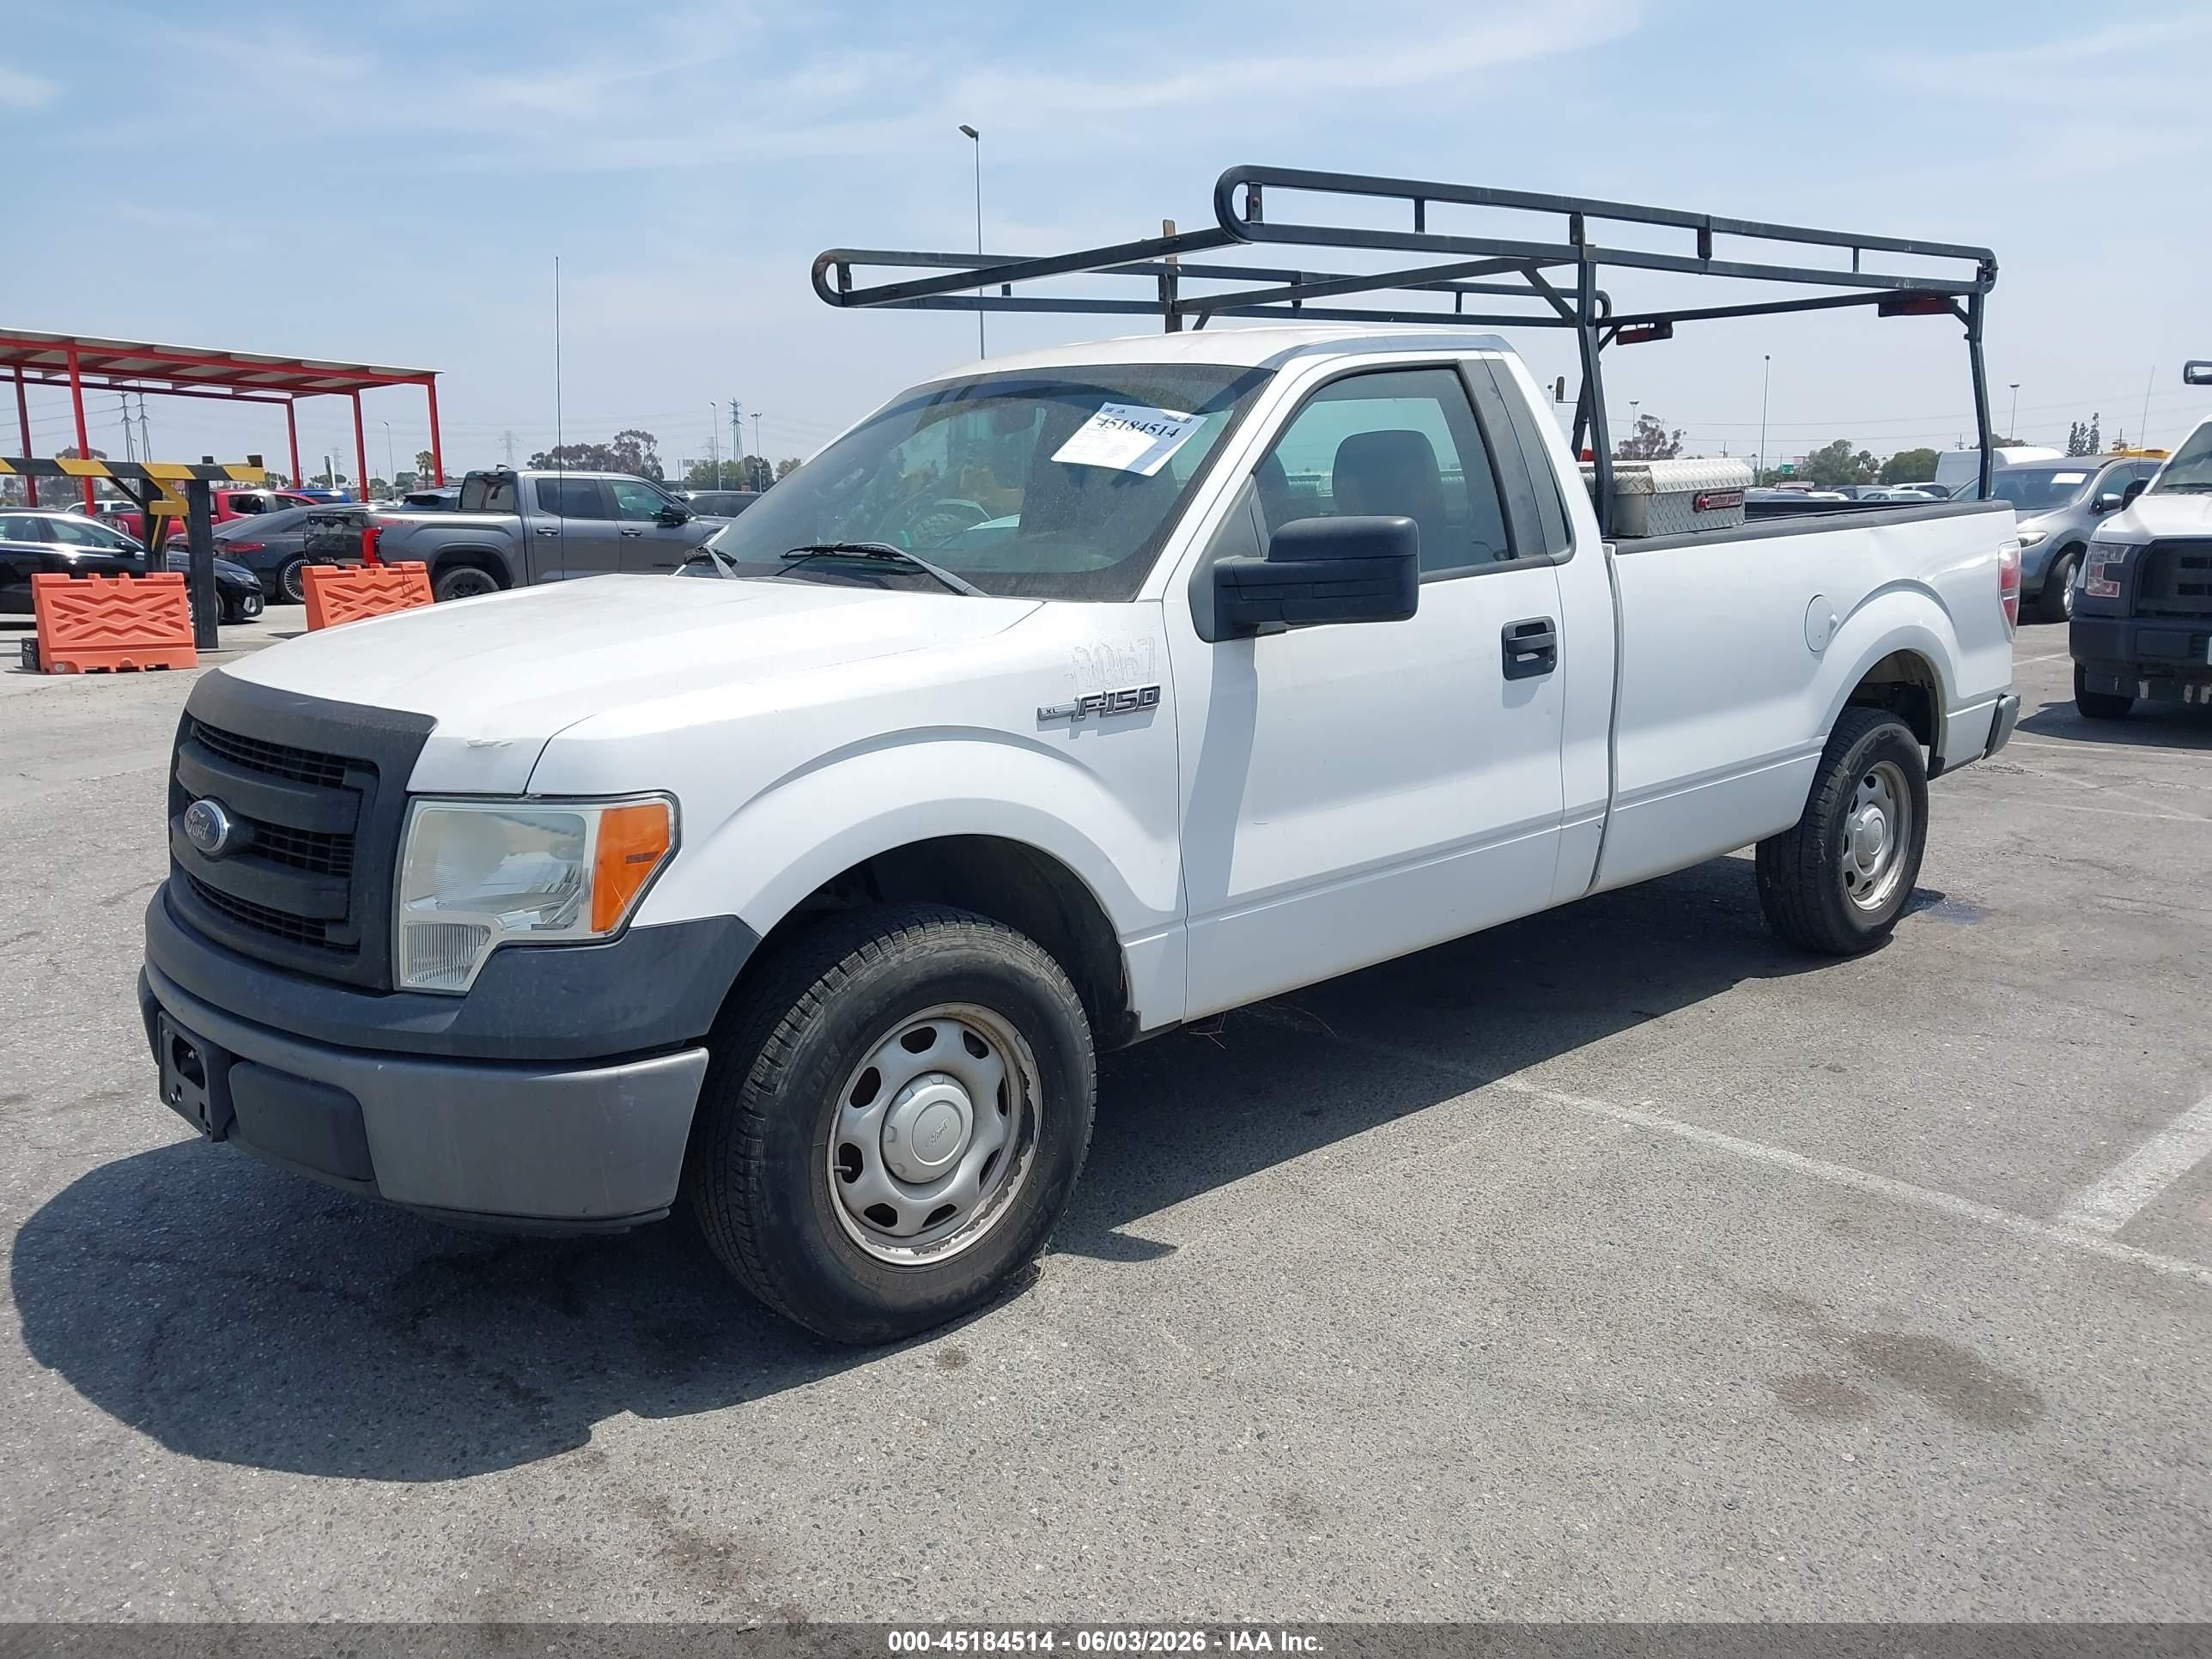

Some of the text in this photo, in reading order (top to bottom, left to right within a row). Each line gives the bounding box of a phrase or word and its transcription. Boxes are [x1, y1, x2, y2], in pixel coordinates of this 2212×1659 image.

[1097, 417, 1182, 439] 45184514
[1045, 684, 1160, 721] XL F-150
[187, 808, 210, 840] Ford
